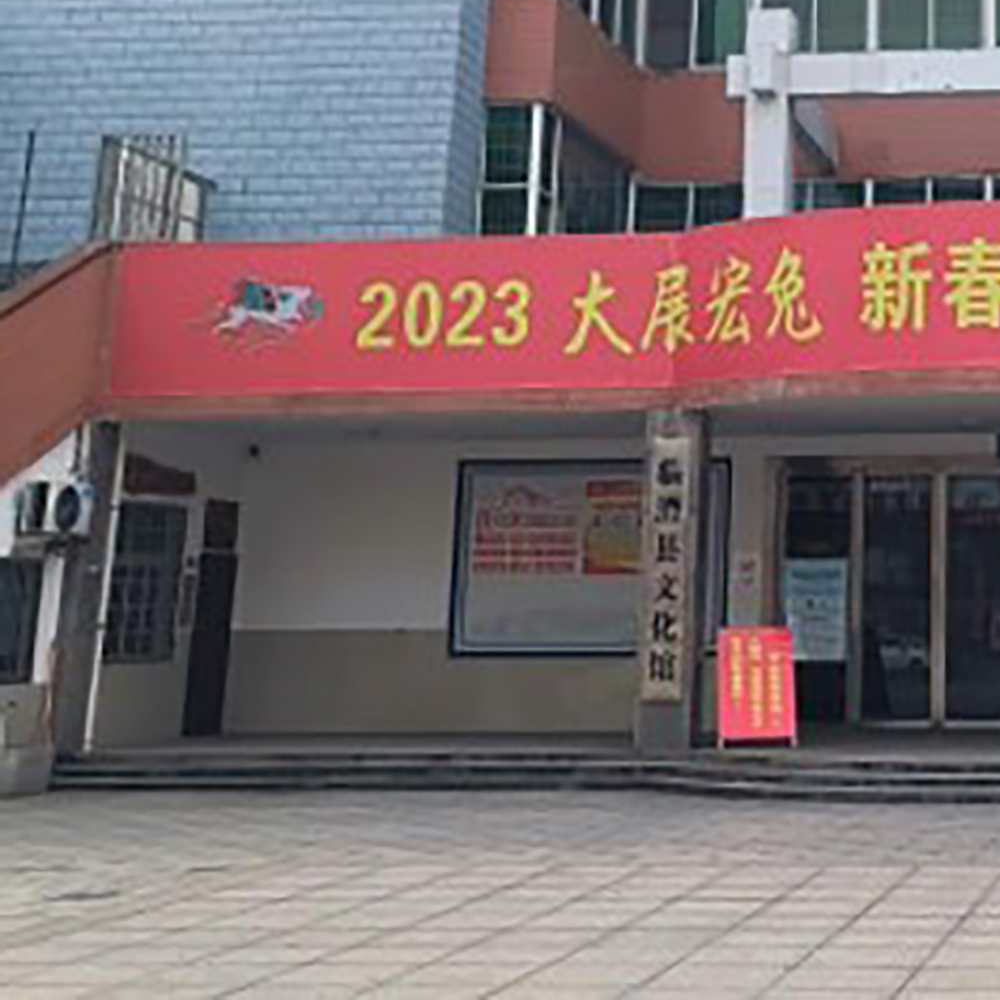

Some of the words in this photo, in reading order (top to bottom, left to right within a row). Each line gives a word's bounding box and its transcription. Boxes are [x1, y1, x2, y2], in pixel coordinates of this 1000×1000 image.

[357, 280, 530, 347] 2023
[565, 249, 822, 354] 大展宏兔
